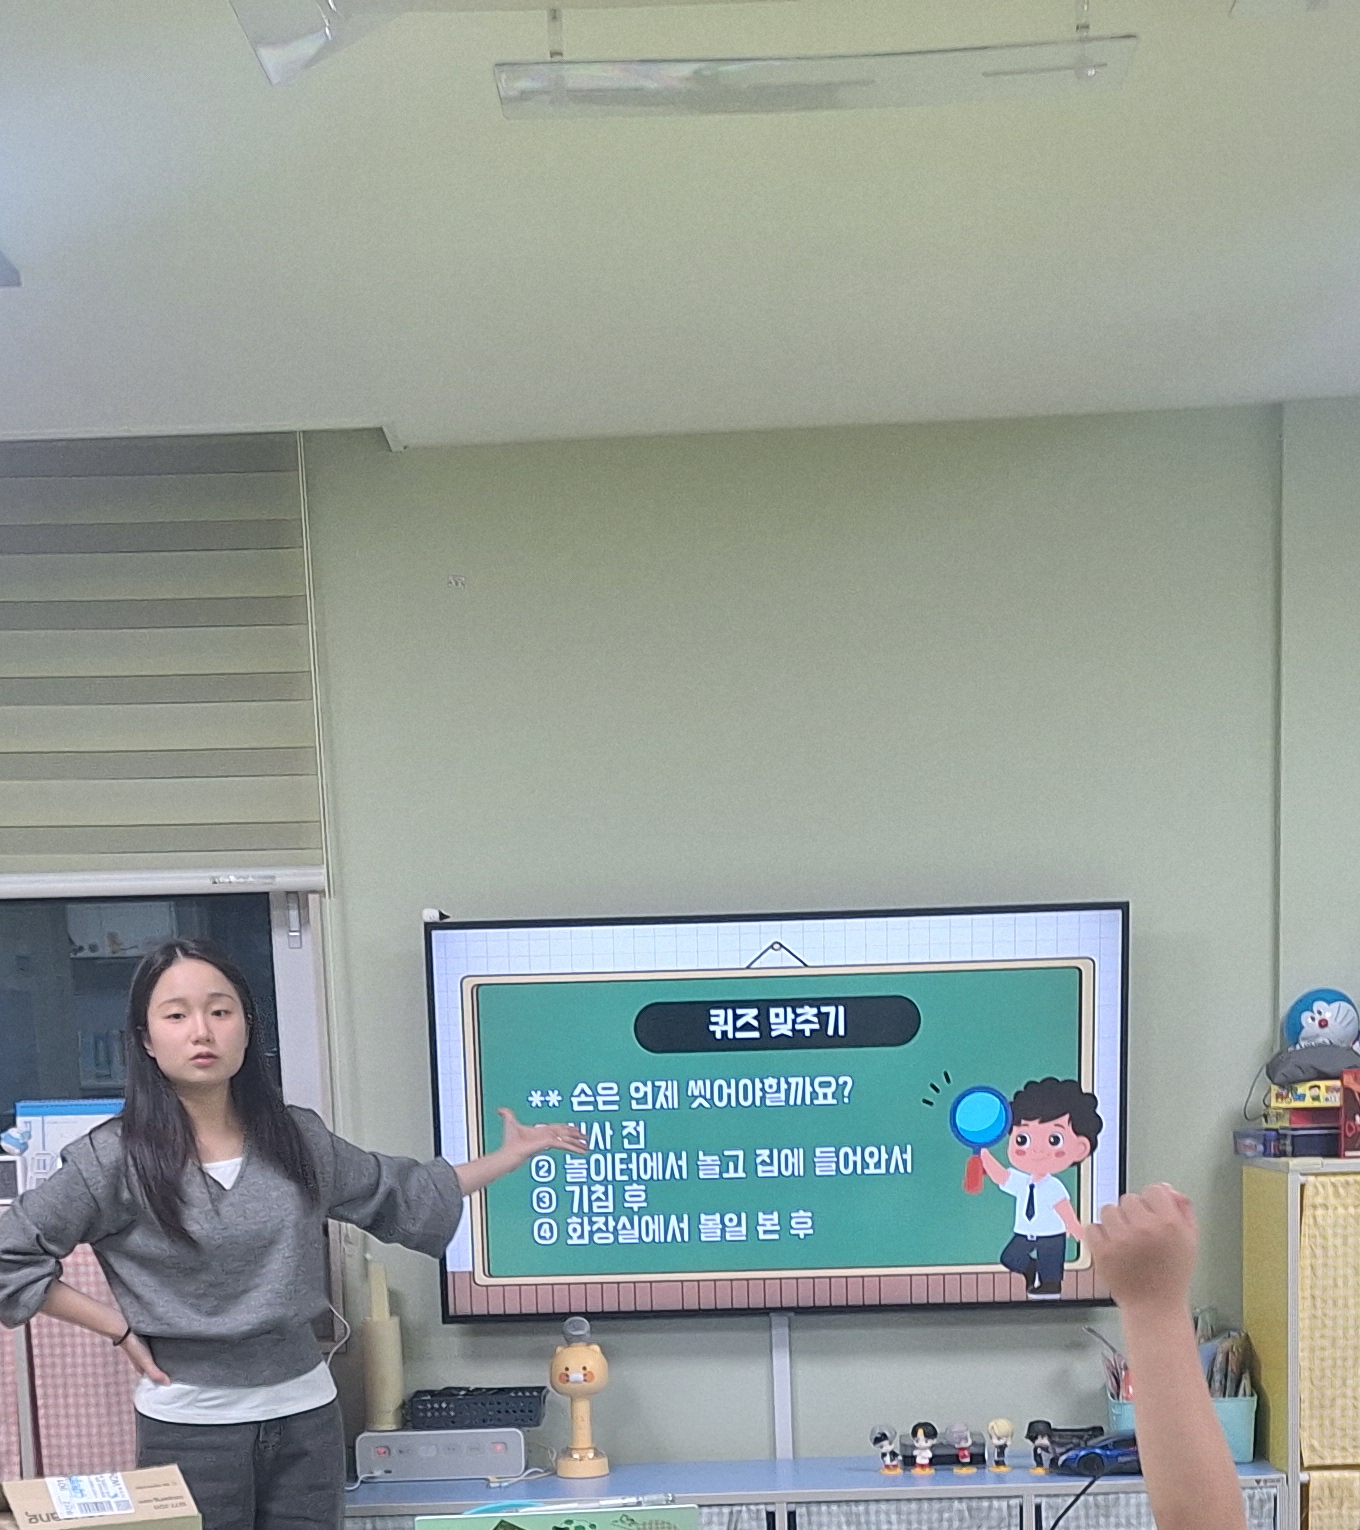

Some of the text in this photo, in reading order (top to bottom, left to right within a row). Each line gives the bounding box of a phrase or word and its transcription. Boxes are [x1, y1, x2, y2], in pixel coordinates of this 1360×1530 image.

[708, 1005, 846, 1040] 퀴즈 맞추기
[570, 1081, 620, 1112] 손은
[629, 1079, 679, 1111] 언제
[686, 1076, 855, 1109] 씻어야할까요?
[621, 1120, 646, 1150] 전
[563, 1151, 688, 1183] 놀이터에서
[696, 1149, 747, 1181] 놀고
[755, 1147, 804, 1178] 집에
[812, 1144, 913, 1177] 들어와서
[564, 1183, 615, 1214] 기침
[623, 1183, 648, 1212] 후
[566, 1214, 690, 1246] 화장실에서
[698, 1212, 748, 1242] 볼일
[756, 1210, 781, 1241] 본
[789, 1209, 815, 1239] 후
